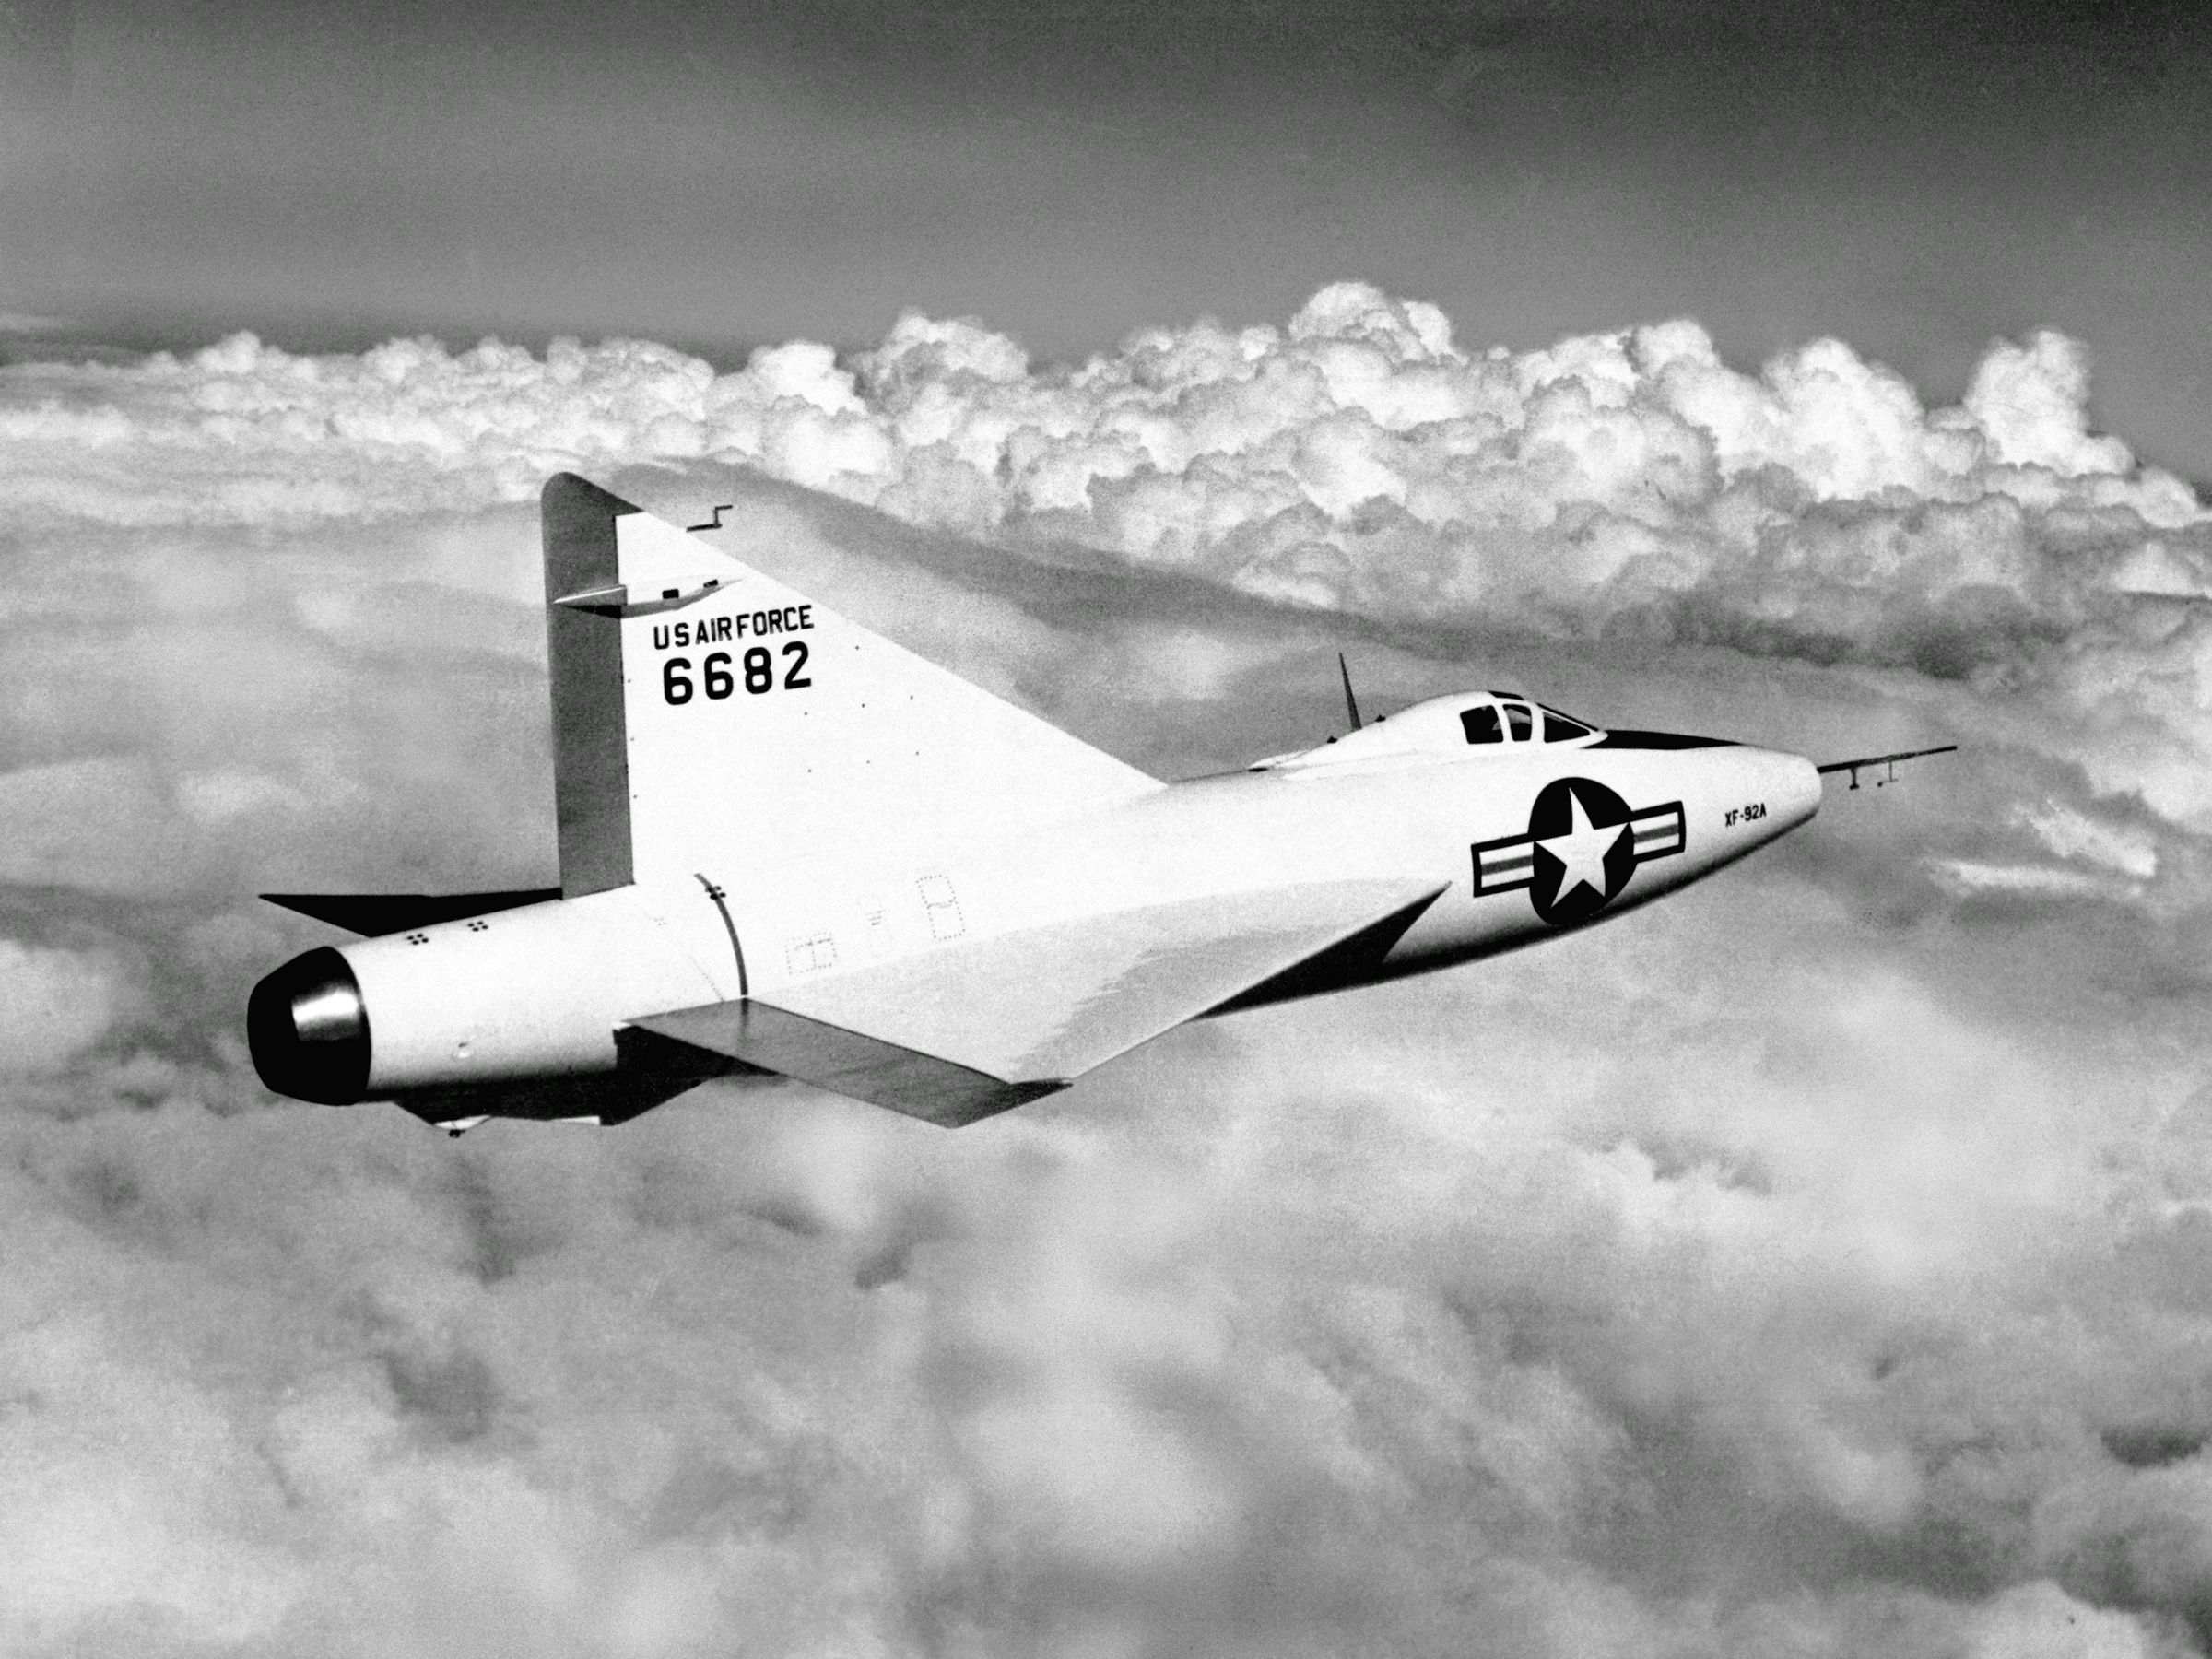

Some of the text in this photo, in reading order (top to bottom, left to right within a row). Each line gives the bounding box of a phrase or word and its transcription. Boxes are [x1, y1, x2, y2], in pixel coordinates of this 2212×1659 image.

[653, 605, 814, 650] US AIR FORCE
[663, 641, 812, 706] 6682
[1724, 802, 1767, 828] XF-92A
